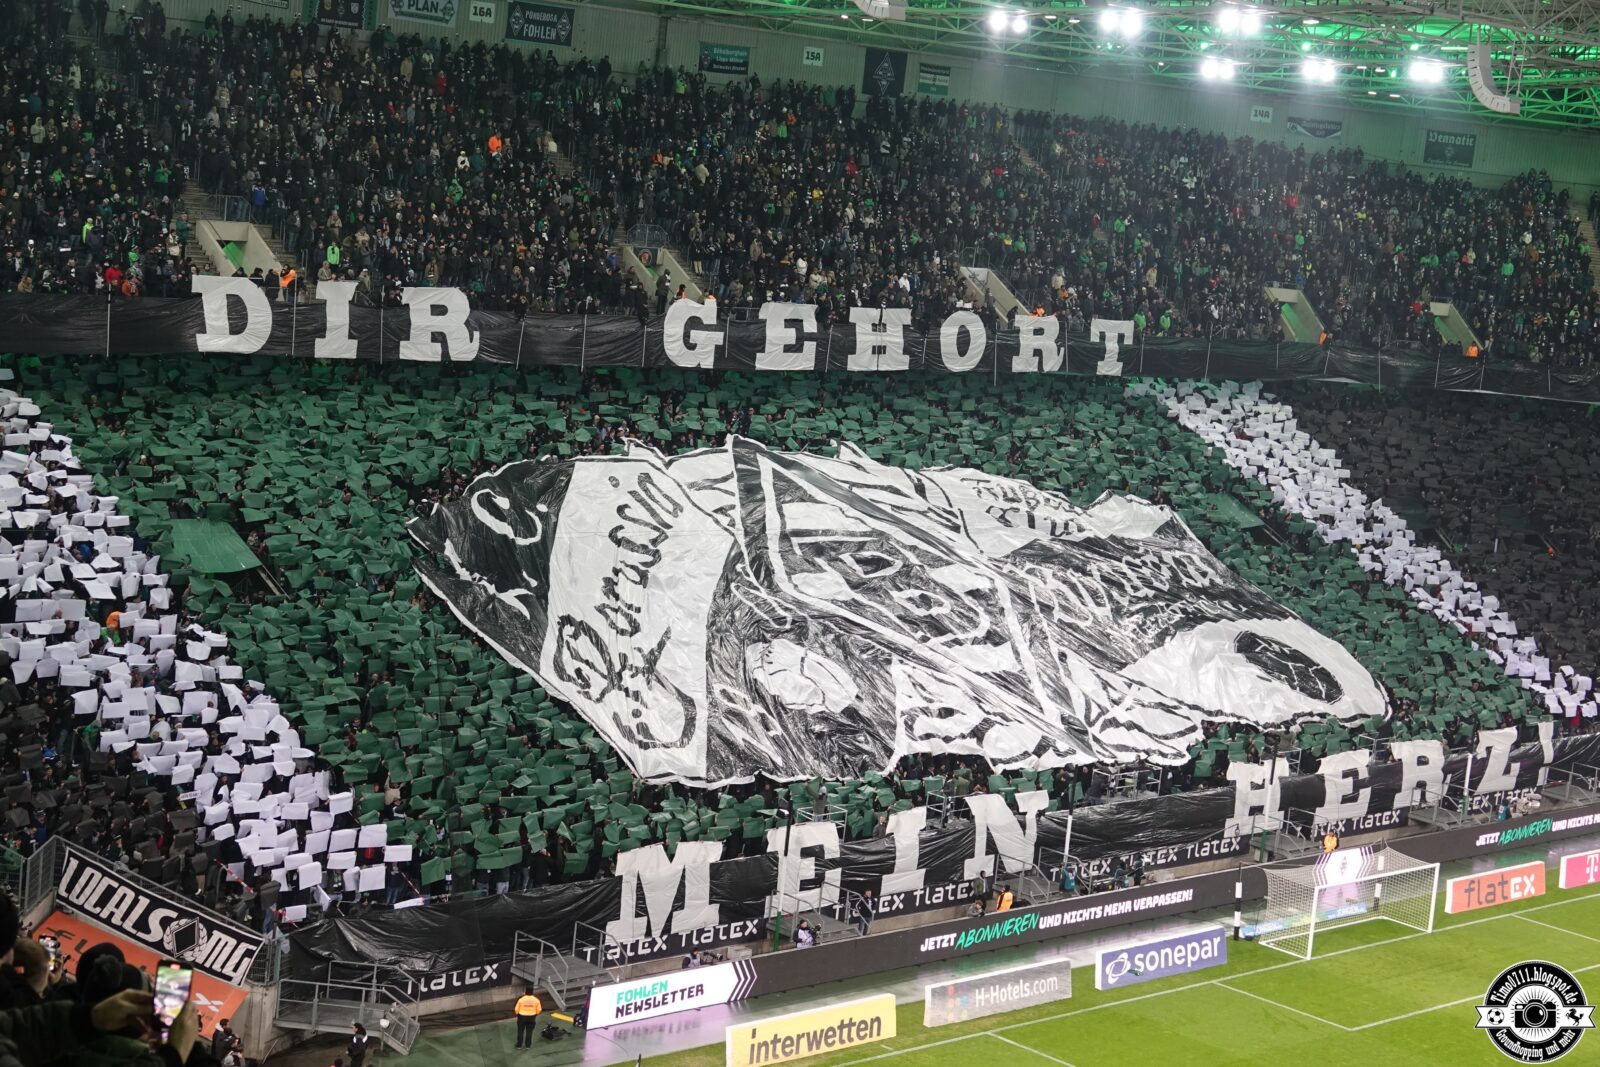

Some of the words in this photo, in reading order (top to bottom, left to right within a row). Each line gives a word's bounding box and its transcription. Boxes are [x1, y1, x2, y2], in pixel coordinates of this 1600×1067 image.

[472, 6, 492, 18] 16A
[806, 51, 820, 61] 15A
[1253, 109, 1270, 119] 14A
[192, 274, 480, 362] DIR
[605, 790, 1049, 946] MEIN
[1223, 719, 1554, 838] HERZ!
[1475, 831, 1501, 847] JETZT
[1498, 817, 1553, 845] ABONNIEREN
[1464, 874, 1536, 908] flatEX
[58, 856, 178, 943] LOCALS
[199, 929, 258, 987] MG
[920, 932, 957, 952] JETZT
[955, 911, 1040, 950] ABONNIEREN
[1039, 910, 1061, 930] UND
[1063, 904, 1102, 925] NICHTS
[1104, 900, 1132, 918] MEHR
[1133, 888, 1194, 911] VERPASSEN!
[1134, 934, 1221, 975] sonepar
[615, 984, 704, 1019] NEWSLETTER
[616, 979, 668, 1005] FOHLEN
[975, 975, 1059, 1008] H-Hotels.com
[748, 1012, 882, 1065] interwetten
